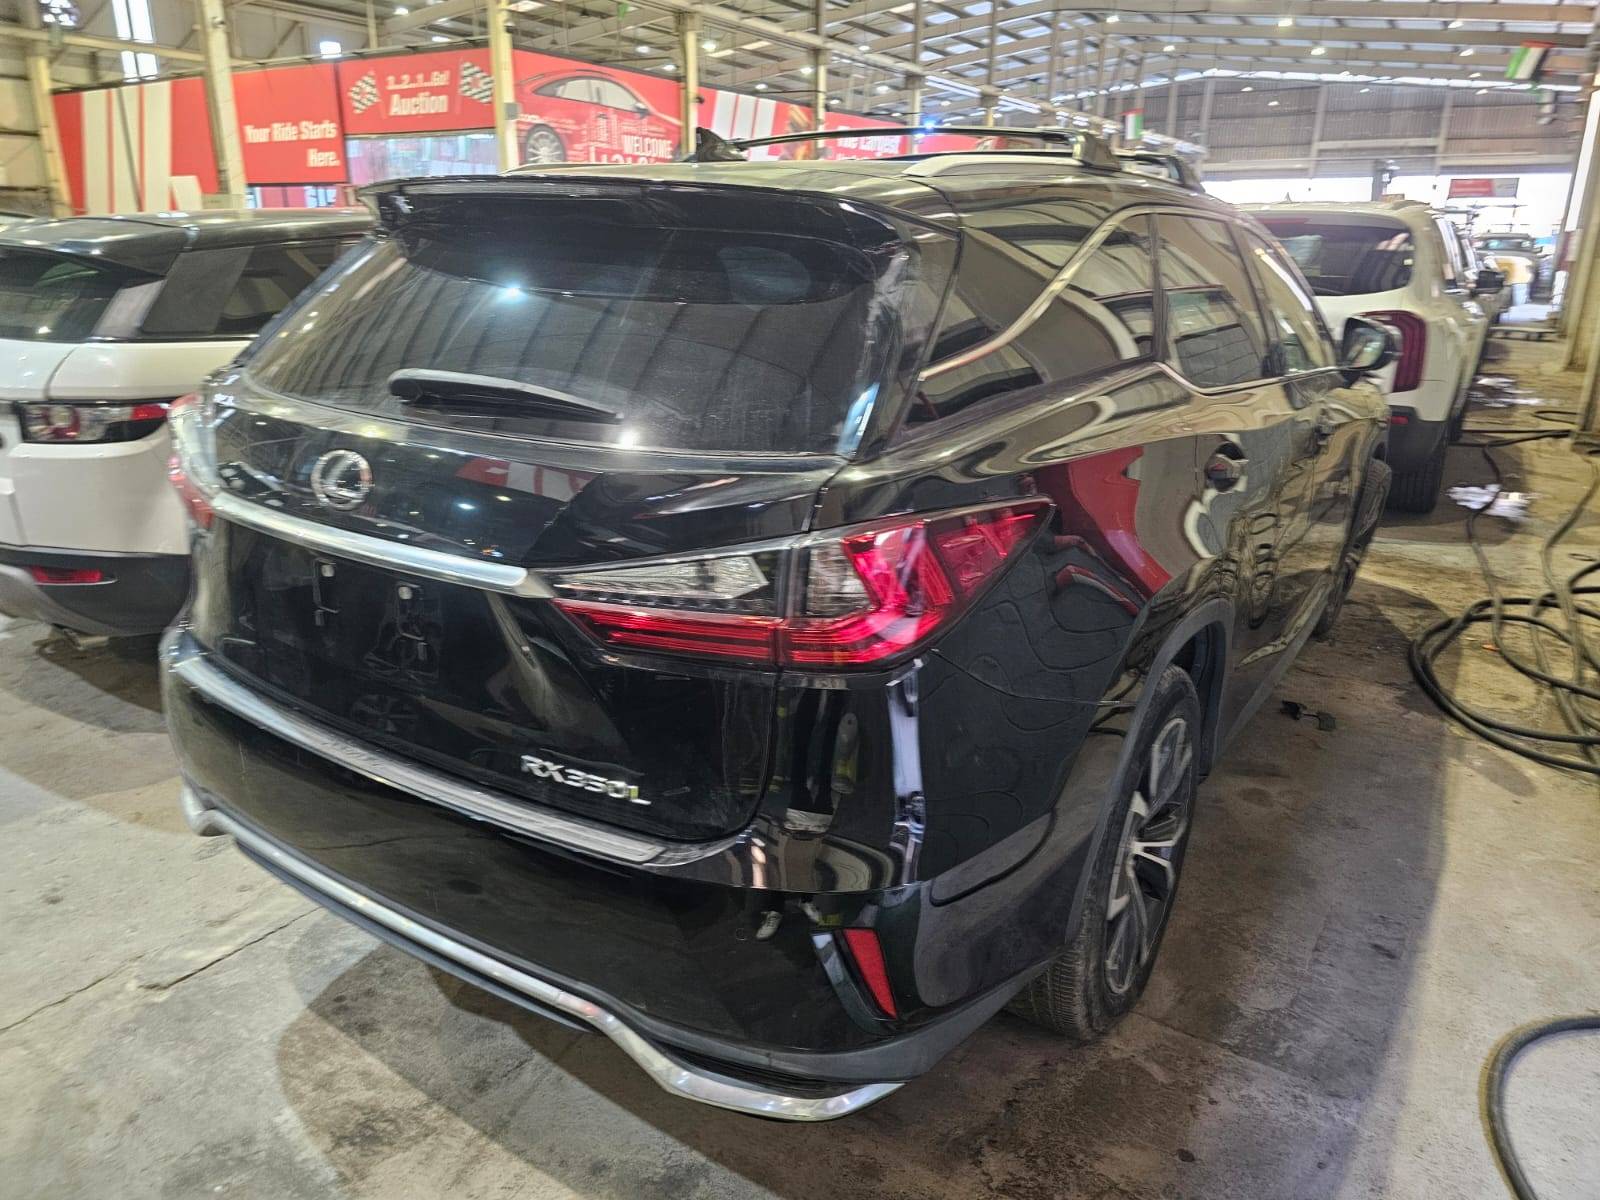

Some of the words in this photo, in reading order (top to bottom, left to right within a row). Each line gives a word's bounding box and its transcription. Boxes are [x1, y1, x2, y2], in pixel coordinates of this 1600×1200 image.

[389, 92, 448, 116] Auction
[244, 124, 270, 143] Your
[271, 122, 299, 141] Ride
[299, 120, 338, 140] Starts
[307, 148, 340, 167] Here.
[622, 134, 674, 159] WELCOME
